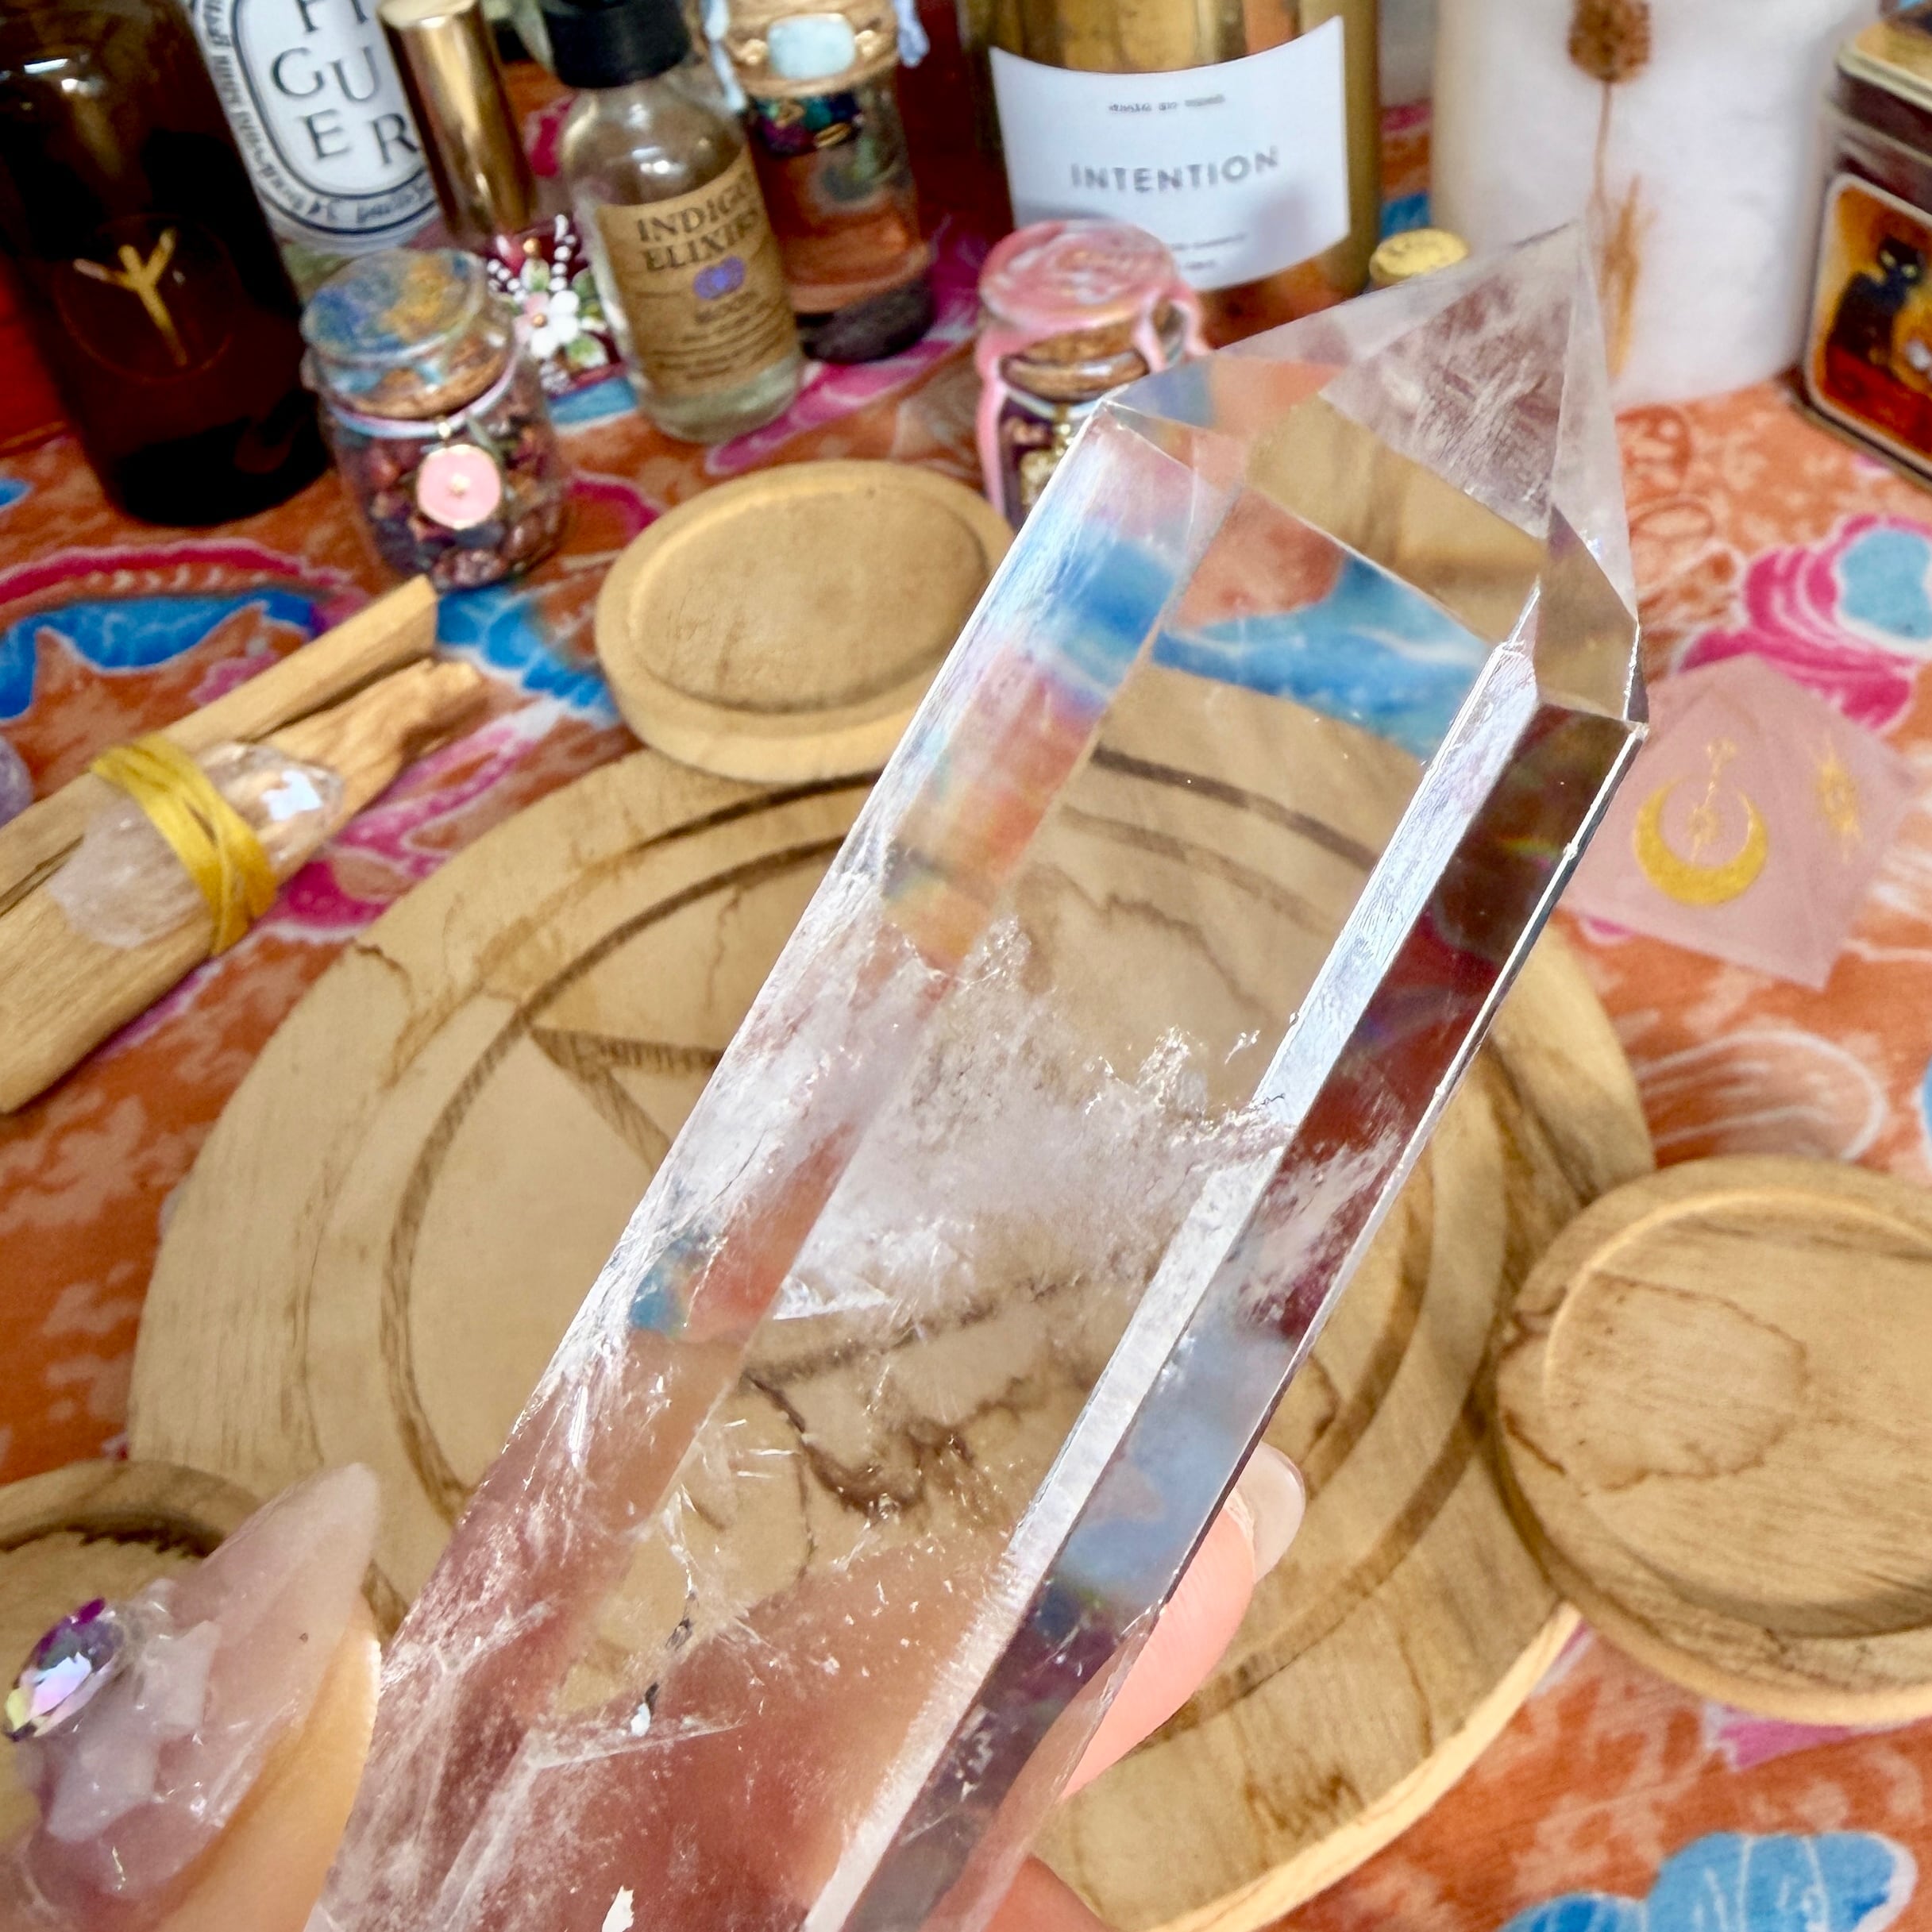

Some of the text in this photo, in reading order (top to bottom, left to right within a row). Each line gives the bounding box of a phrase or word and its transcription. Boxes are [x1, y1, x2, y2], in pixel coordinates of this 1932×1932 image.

[271, 46, 380, 102] GU
[298, 108, 418, 165] ER
[1070, 145, 1279, 194] INTENTION
